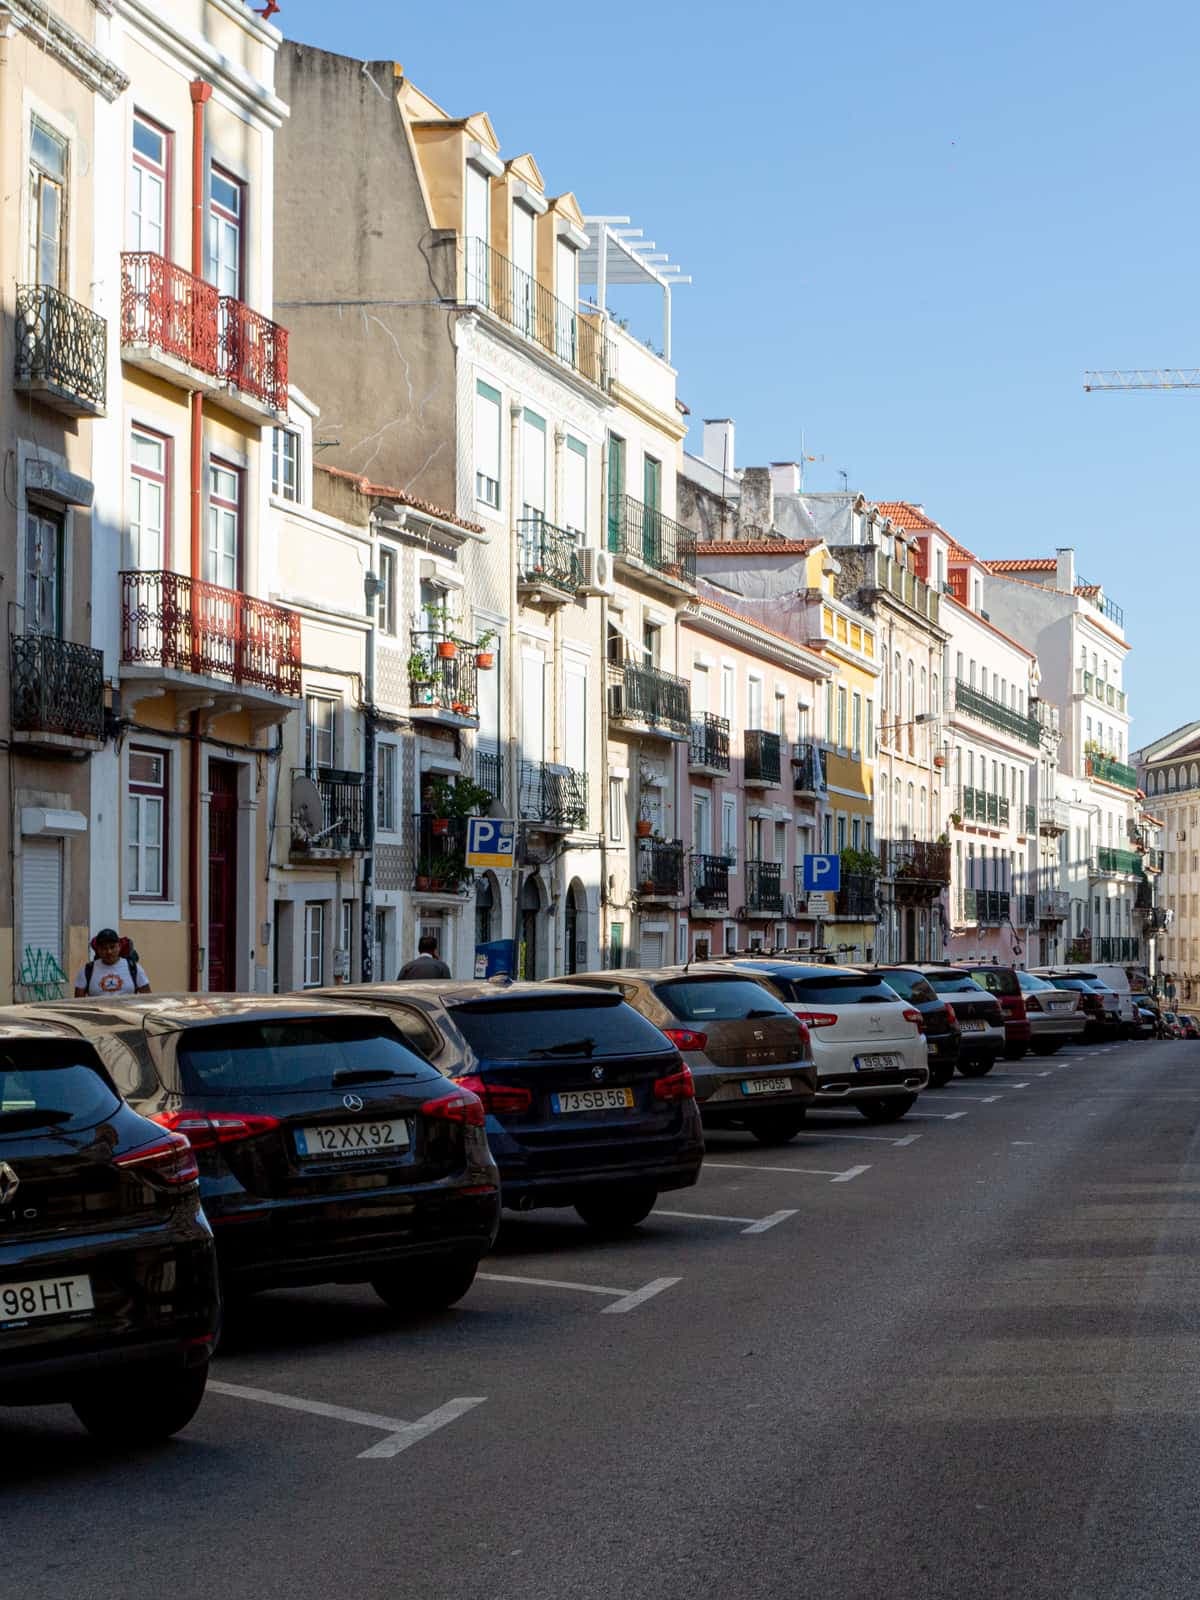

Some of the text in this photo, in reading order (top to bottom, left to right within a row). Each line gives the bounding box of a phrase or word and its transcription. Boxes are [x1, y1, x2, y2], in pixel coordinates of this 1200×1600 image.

[473, 821, 495, 852] P
[813, 857, 831, 882] P
[317, 1124, 395, 1149] 12XX92
[2, 1281, 75, 1316] 98HT
